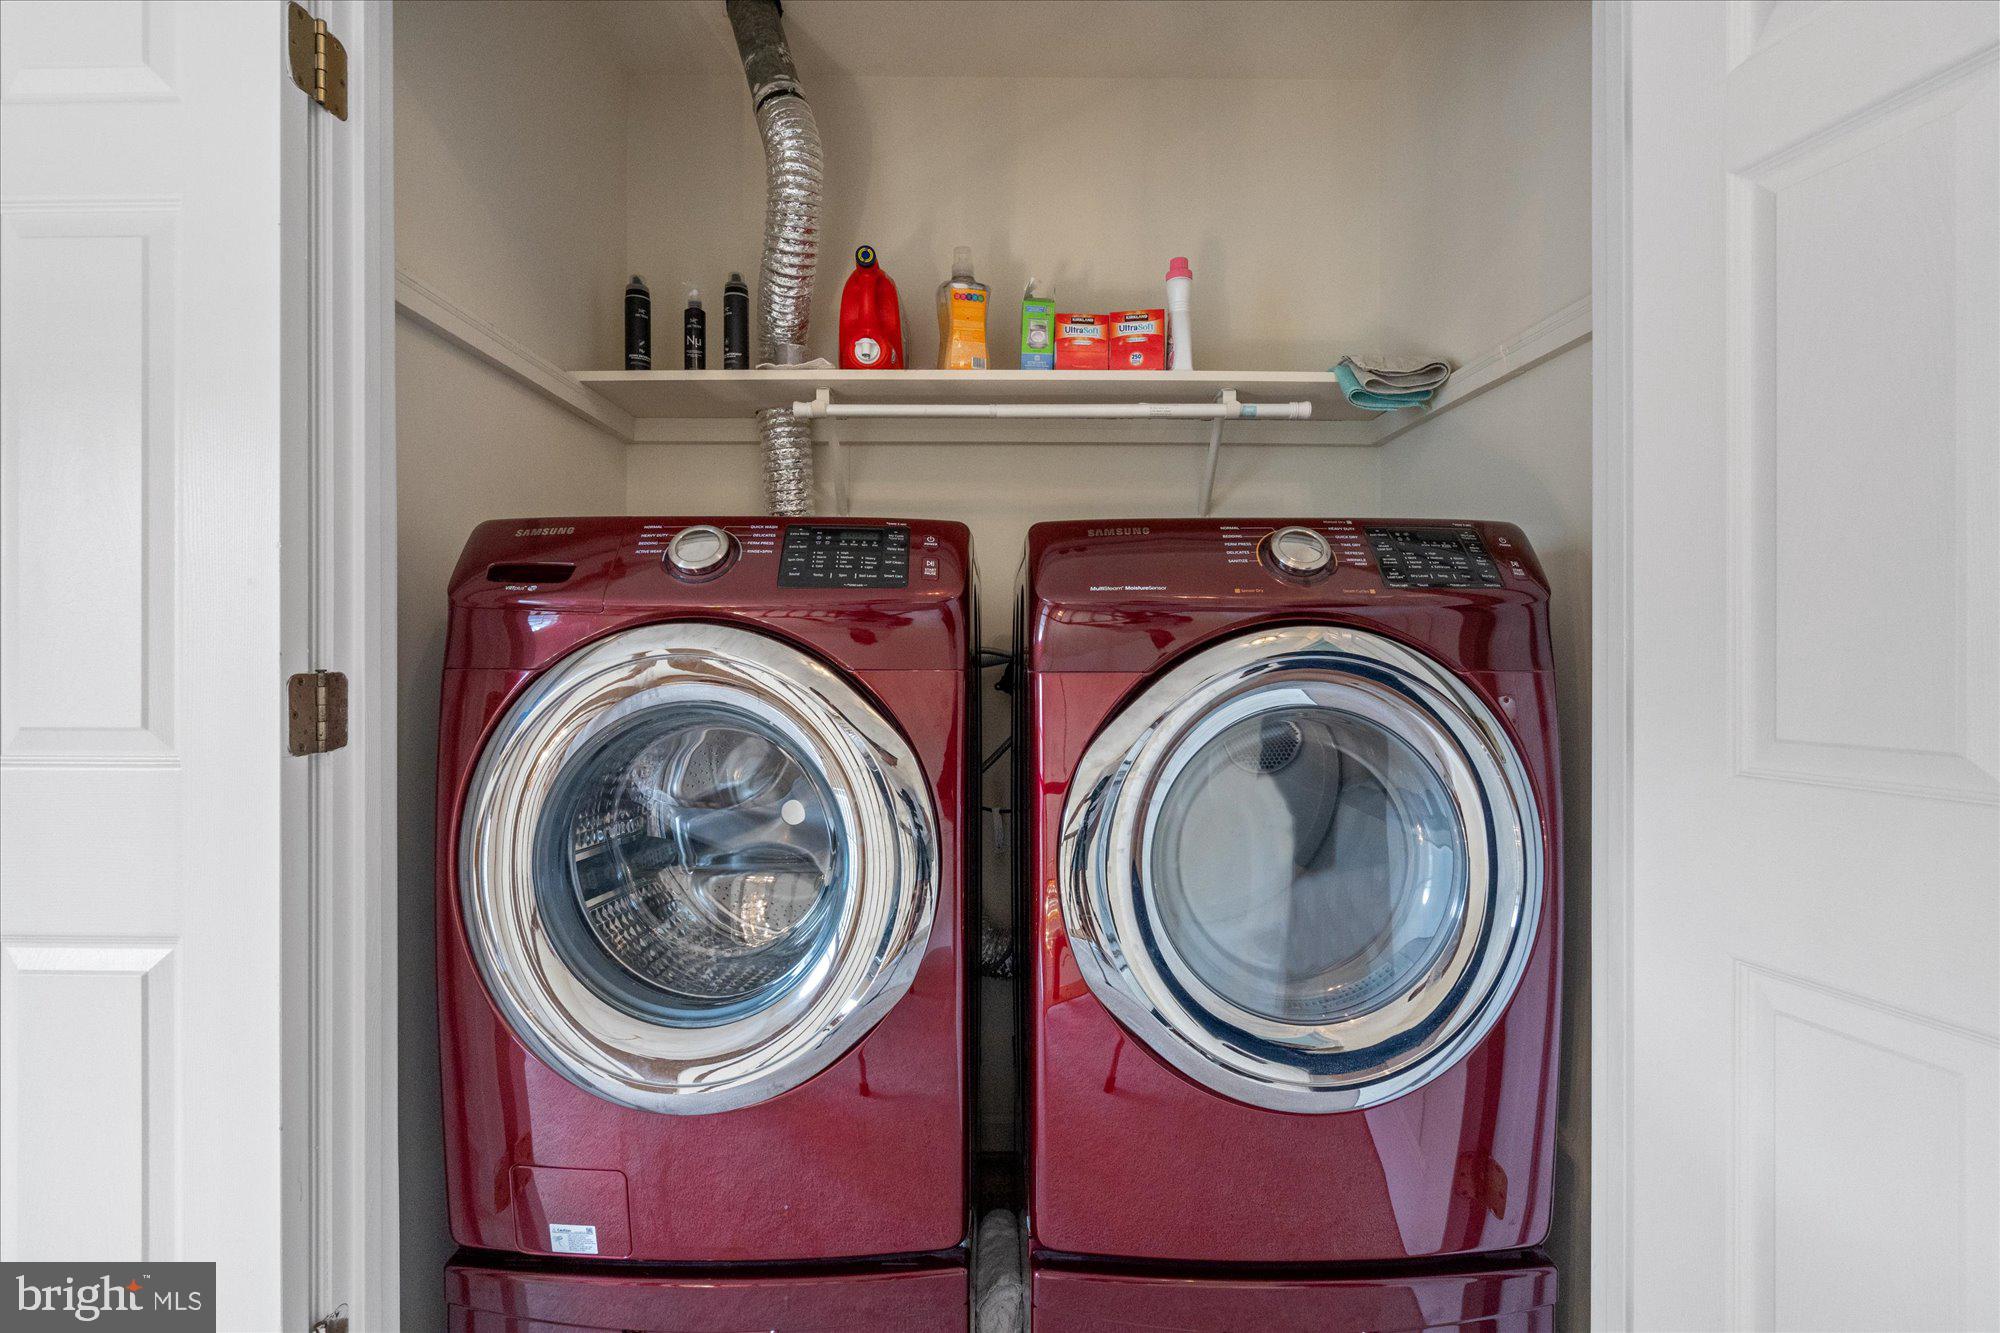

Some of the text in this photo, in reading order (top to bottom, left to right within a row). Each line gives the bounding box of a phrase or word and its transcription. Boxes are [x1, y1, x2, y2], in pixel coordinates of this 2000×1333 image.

[1064, 326, 1100, 334] UltraSoft
[1119, 324, 1154, 332] UltraSoft
[515, 526, 575, 536] SAMSUNG
[1087, 526, 1150, 536] SAMSUNG
